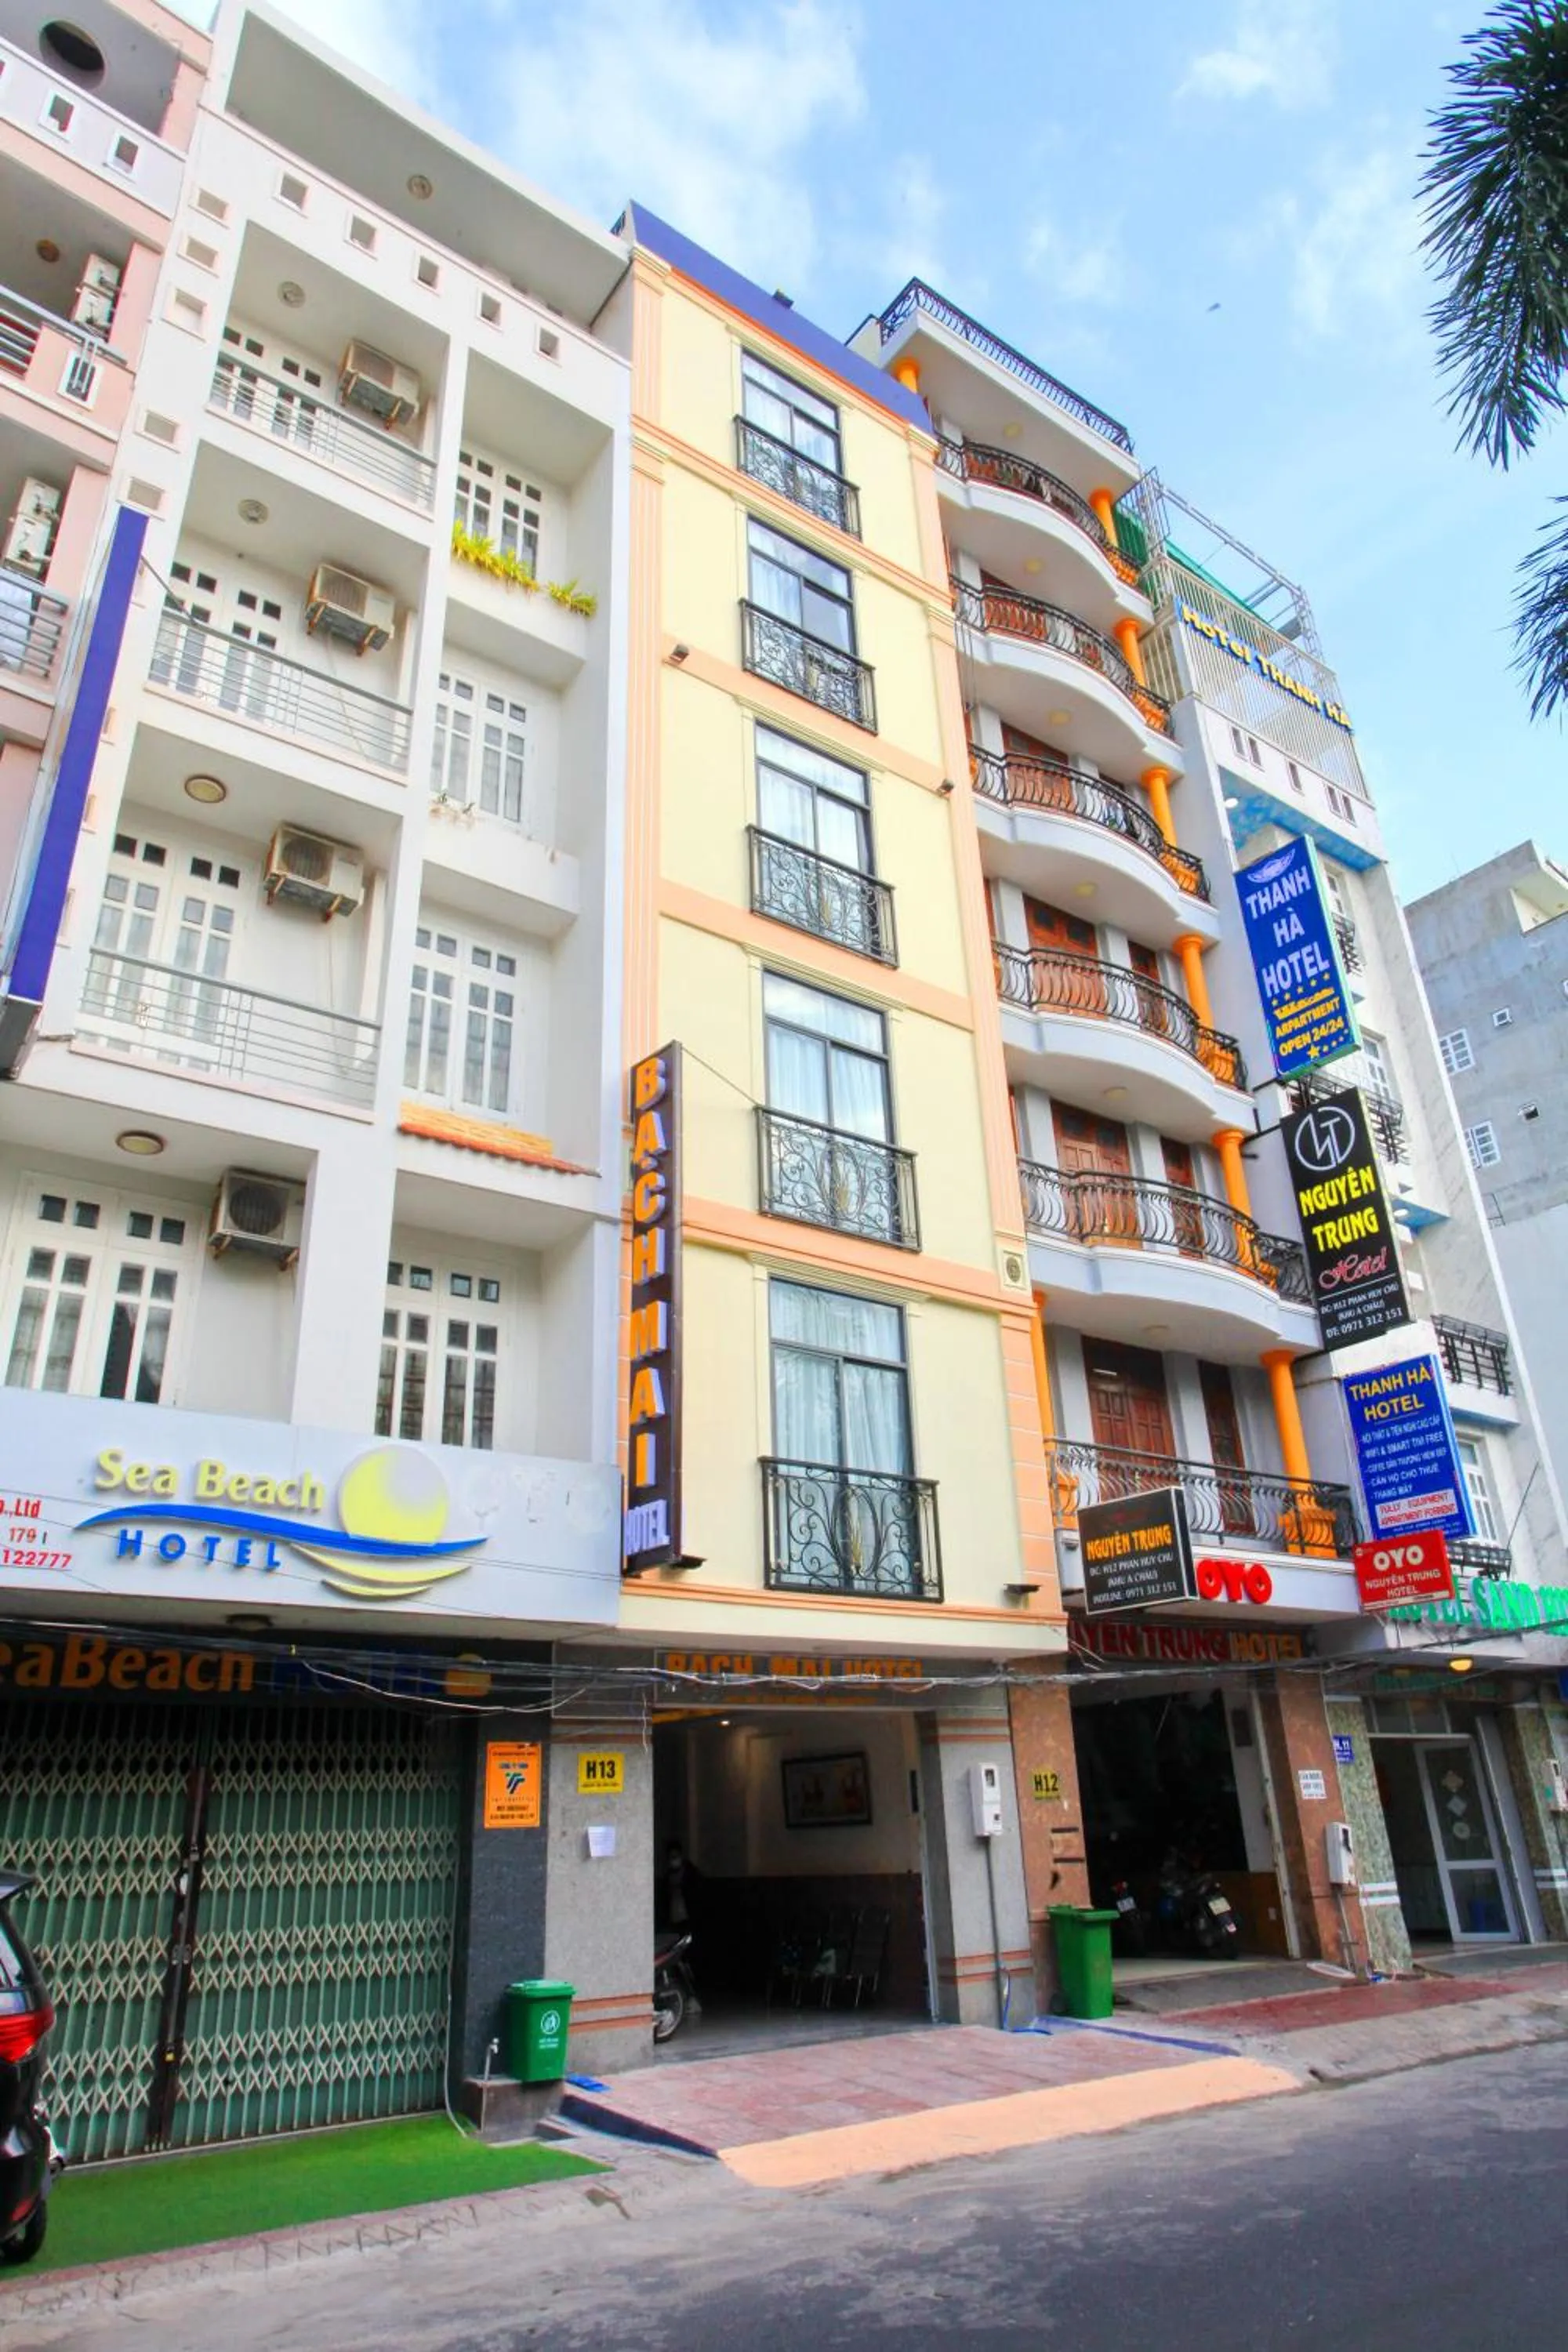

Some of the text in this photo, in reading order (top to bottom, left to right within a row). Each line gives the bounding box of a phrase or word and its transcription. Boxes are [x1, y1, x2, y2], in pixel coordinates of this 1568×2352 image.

[1246, 865, 1312, 920] THANH
[1272, 906, 1305, 948] HÀ
[1261, 941, 1330, 998] HOTEL
[1279, 1015, 1345, 1056] OPEN 24/24
[632, 1055, 666, 1286] BẠCH
[1312, 1207, 1380, 1253] TRUNG
[1341, 1319, 1363, 1334] 0971
[1365, 1312, 1384, 1327] 312
[1385, 1307, 1403, 1320] 151
[628, 1299, 666, 1486] MAI
[1350, 1361, 1432, 1402] THANH HÀ
[1364, 1395, 1425, 1421] HOTEL
[1425, 1431, 1443, 1443] FREE
[95, 1448, 325, 1513] Sea Beach
[1400, 1469, 1417, 1480] CHO
[117, 1528, 281, 1571] HOTEL
[1131, 1524, 1173, 1552] TRUNG
[1374, 1544, 1425, 1572] OYO
[1196, 1557, 1272, 1605] OYO
[1386, 1585, 1419, 1599] HOTEL
[1406, 1568, 1442, 1582] TRUNG
[586, 1760, 616, 1780] H13
[1034, 1773, 1058, 1792] H12
